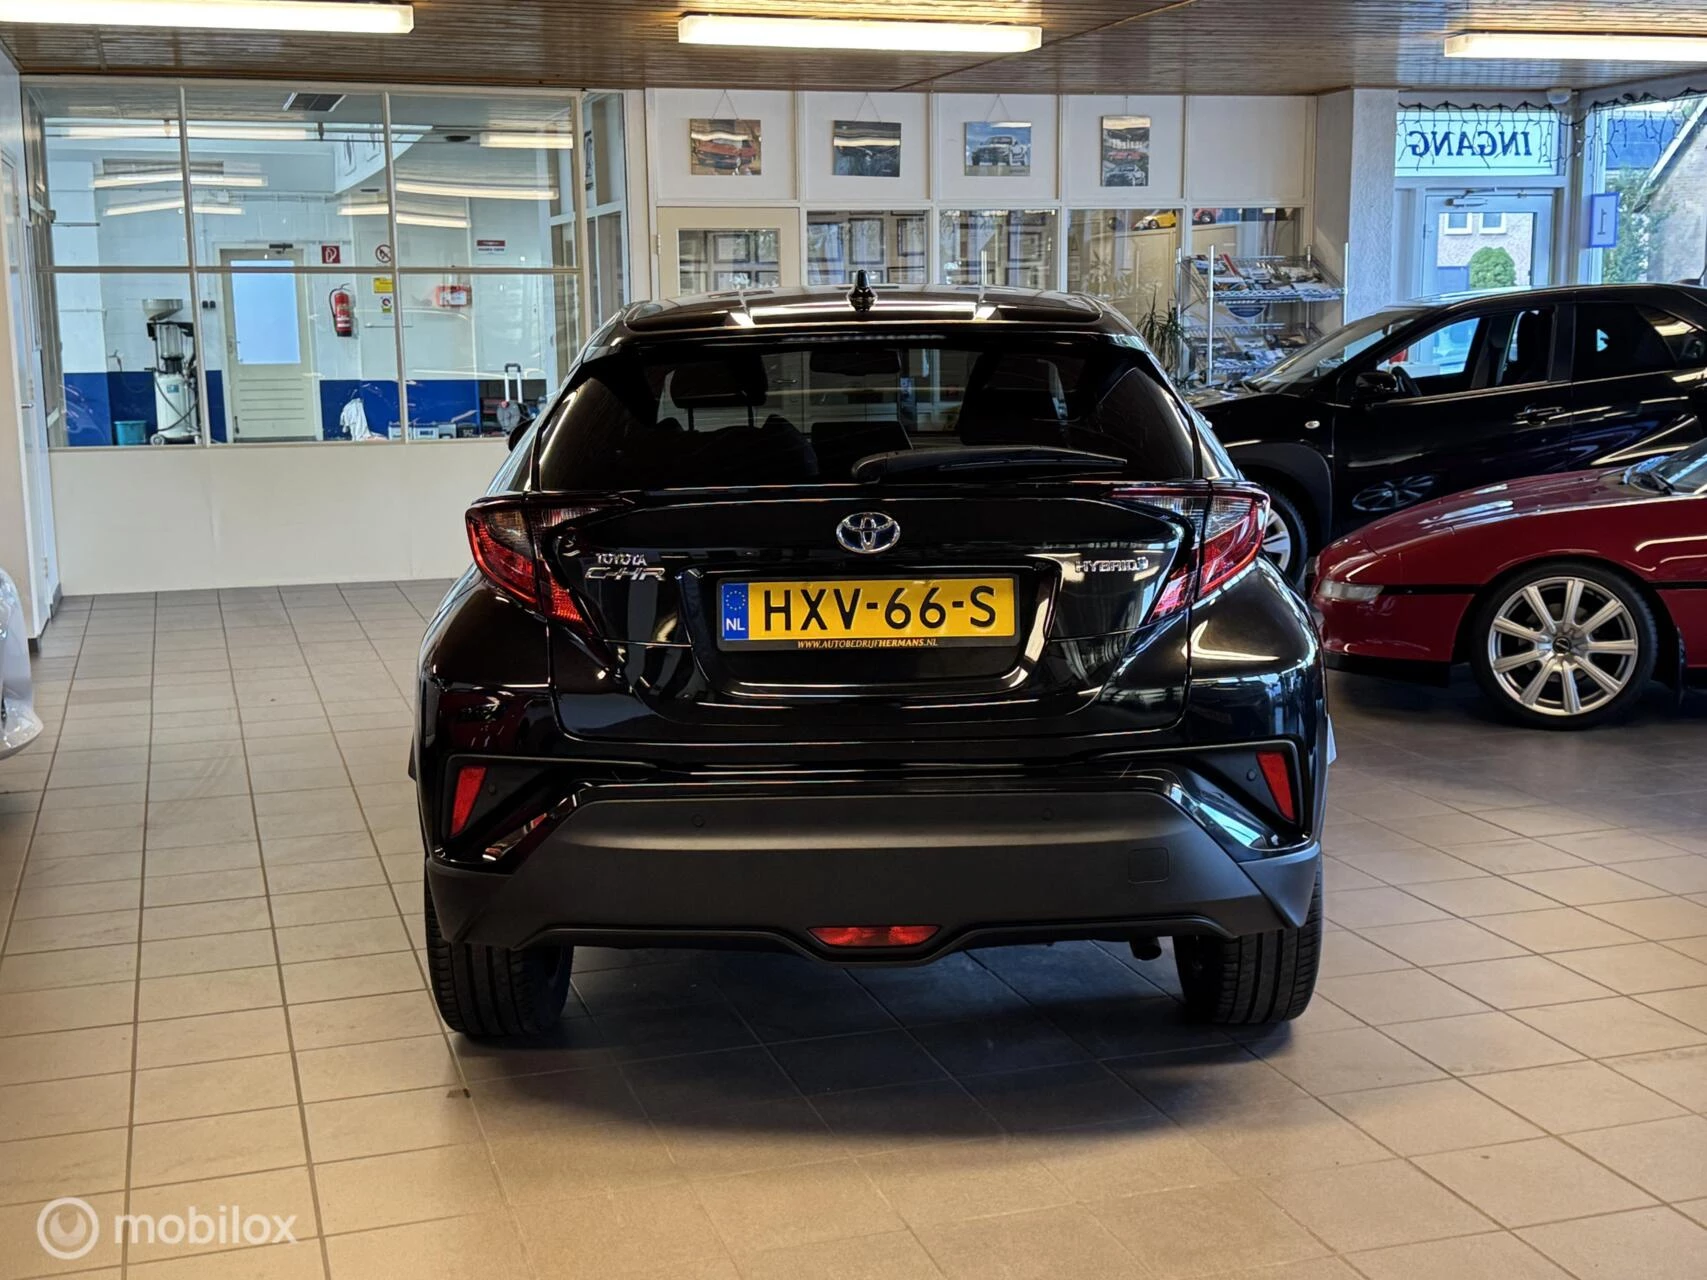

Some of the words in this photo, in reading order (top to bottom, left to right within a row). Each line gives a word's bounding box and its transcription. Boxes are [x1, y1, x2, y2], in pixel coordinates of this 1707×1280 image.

[595, 553, 648, 566] TOYOTA
[1075, 559, 1138, 573] HYBRID
[585, 566, 667, 581] C-HR
[763, 585, 996, 632] HXV-66-S
[725, 618, 745, 631] NL
[797, 638, 938, 649] WWW.AUTOBEDRIJFHERMANS.NL
